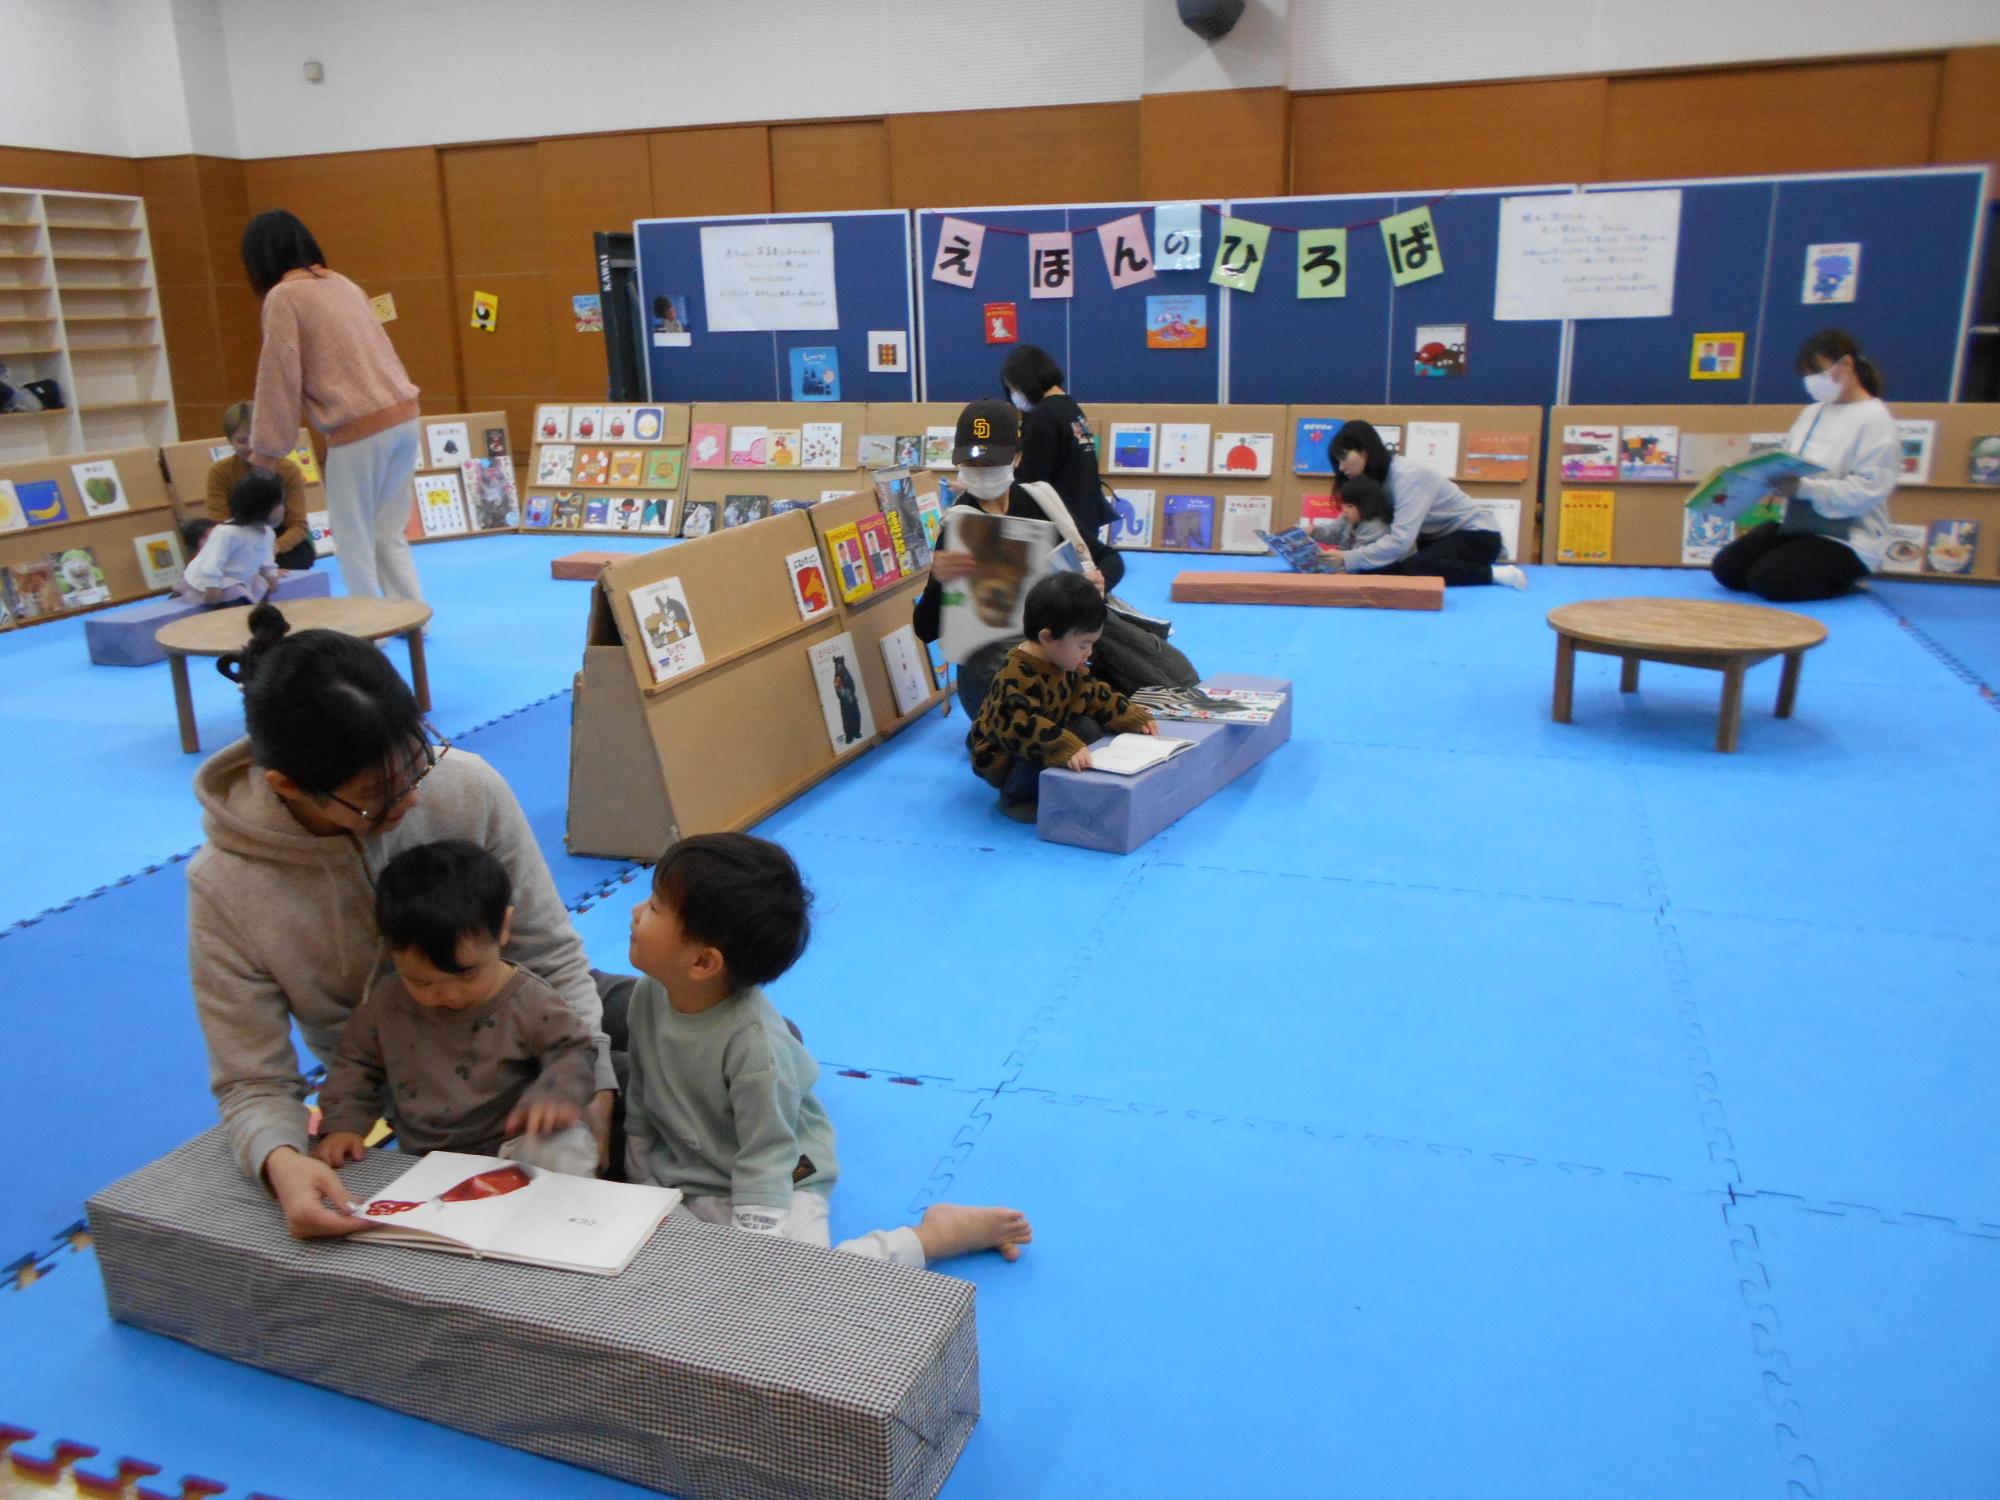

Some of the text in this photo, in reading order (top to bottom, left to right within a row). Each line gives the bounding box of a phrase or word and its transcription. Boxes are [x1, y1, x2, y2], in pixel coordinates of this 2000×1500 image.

[599, 254, 612, 292] KAWAI
[938, 221, 1437, 289] えほんのひろば
[973, 417, 991, 439] SD
